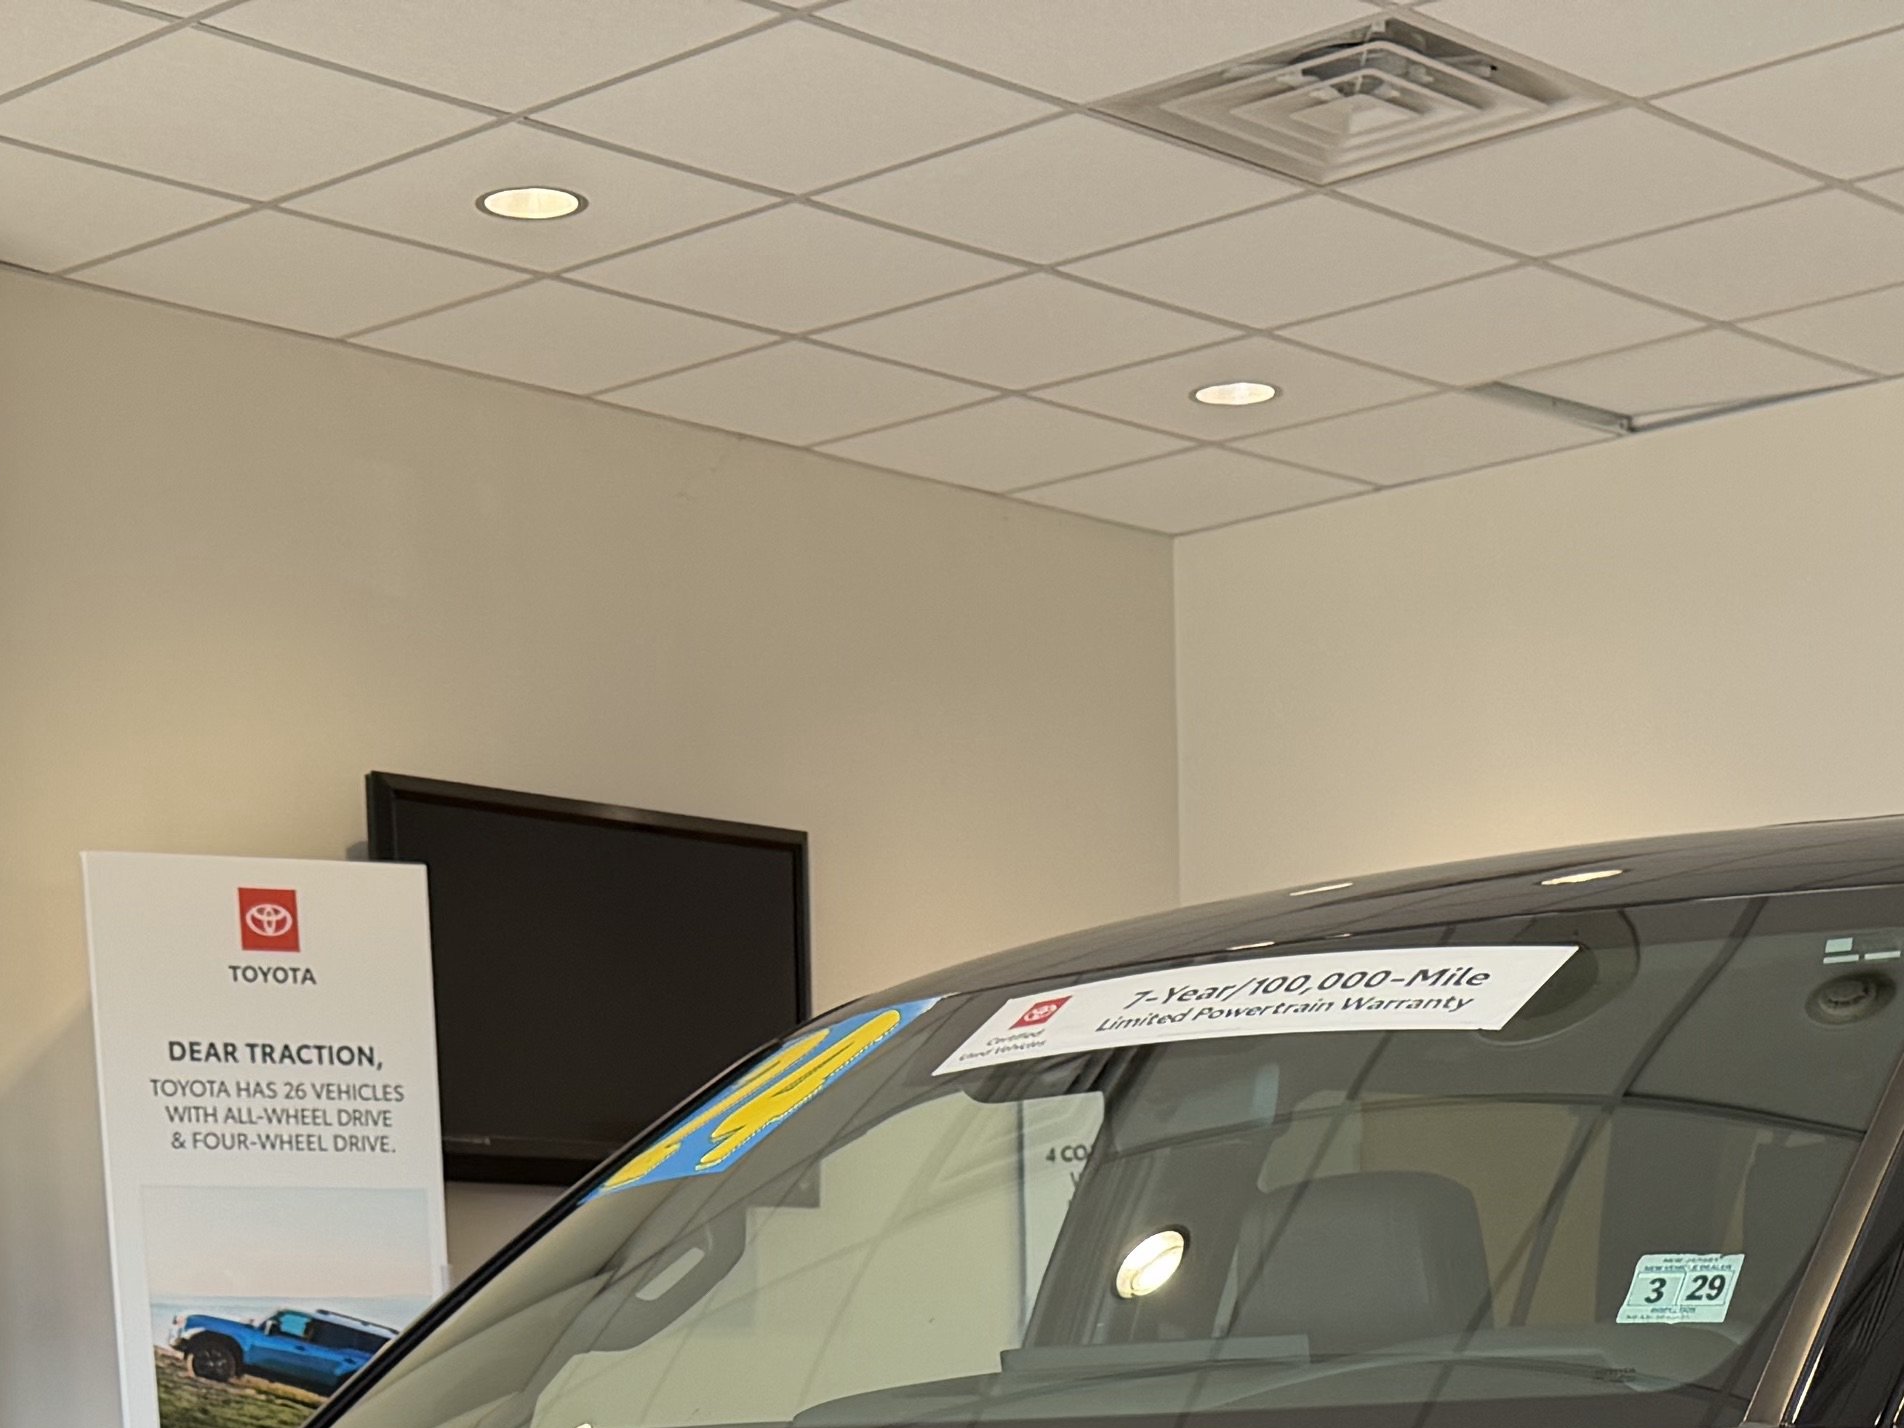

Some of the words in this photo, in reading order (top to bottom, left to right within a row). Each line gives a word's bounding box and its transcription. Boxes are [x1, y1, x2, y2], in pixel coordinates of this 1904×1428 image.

[228, 965, 317, 985] TOYOTA
[1123, 967, 1492, 1009] 7-Year/100,000-Mile
[1095, 1005, 1195, 1033] Limited
[1192, 997, 1334, 1022] Powertrain
[1341, 995, 1475, 1015] Warranty
[168, 1041, 239, 1063] DEAR
[245, 1043, 384, 1071] TRACTION,
[150, 1078, 231, 1099] TOYOTA
[236, 1081, 277, 1099] HAS
[284, 1082, 307, 1100] 26
[310, 1083, 405, 1102] VEHICLES
[165, 1106, 218, 1124] WITH
[223, 1107, 332, 1127] ALL-WHEEL
[337, 1109, 392, 1128] DRIVE
[171, 1131, 186, 1150] &
[193, 1132, 328, 1152] FOUR-WHEEL
[333, 1134, 397, 1153] DRIVE.
[1060, 1144, 1092, 1163] CO
[1644, 1278, 1667, 1304] 3
[1685, 1274, 1726, 1301] 29
